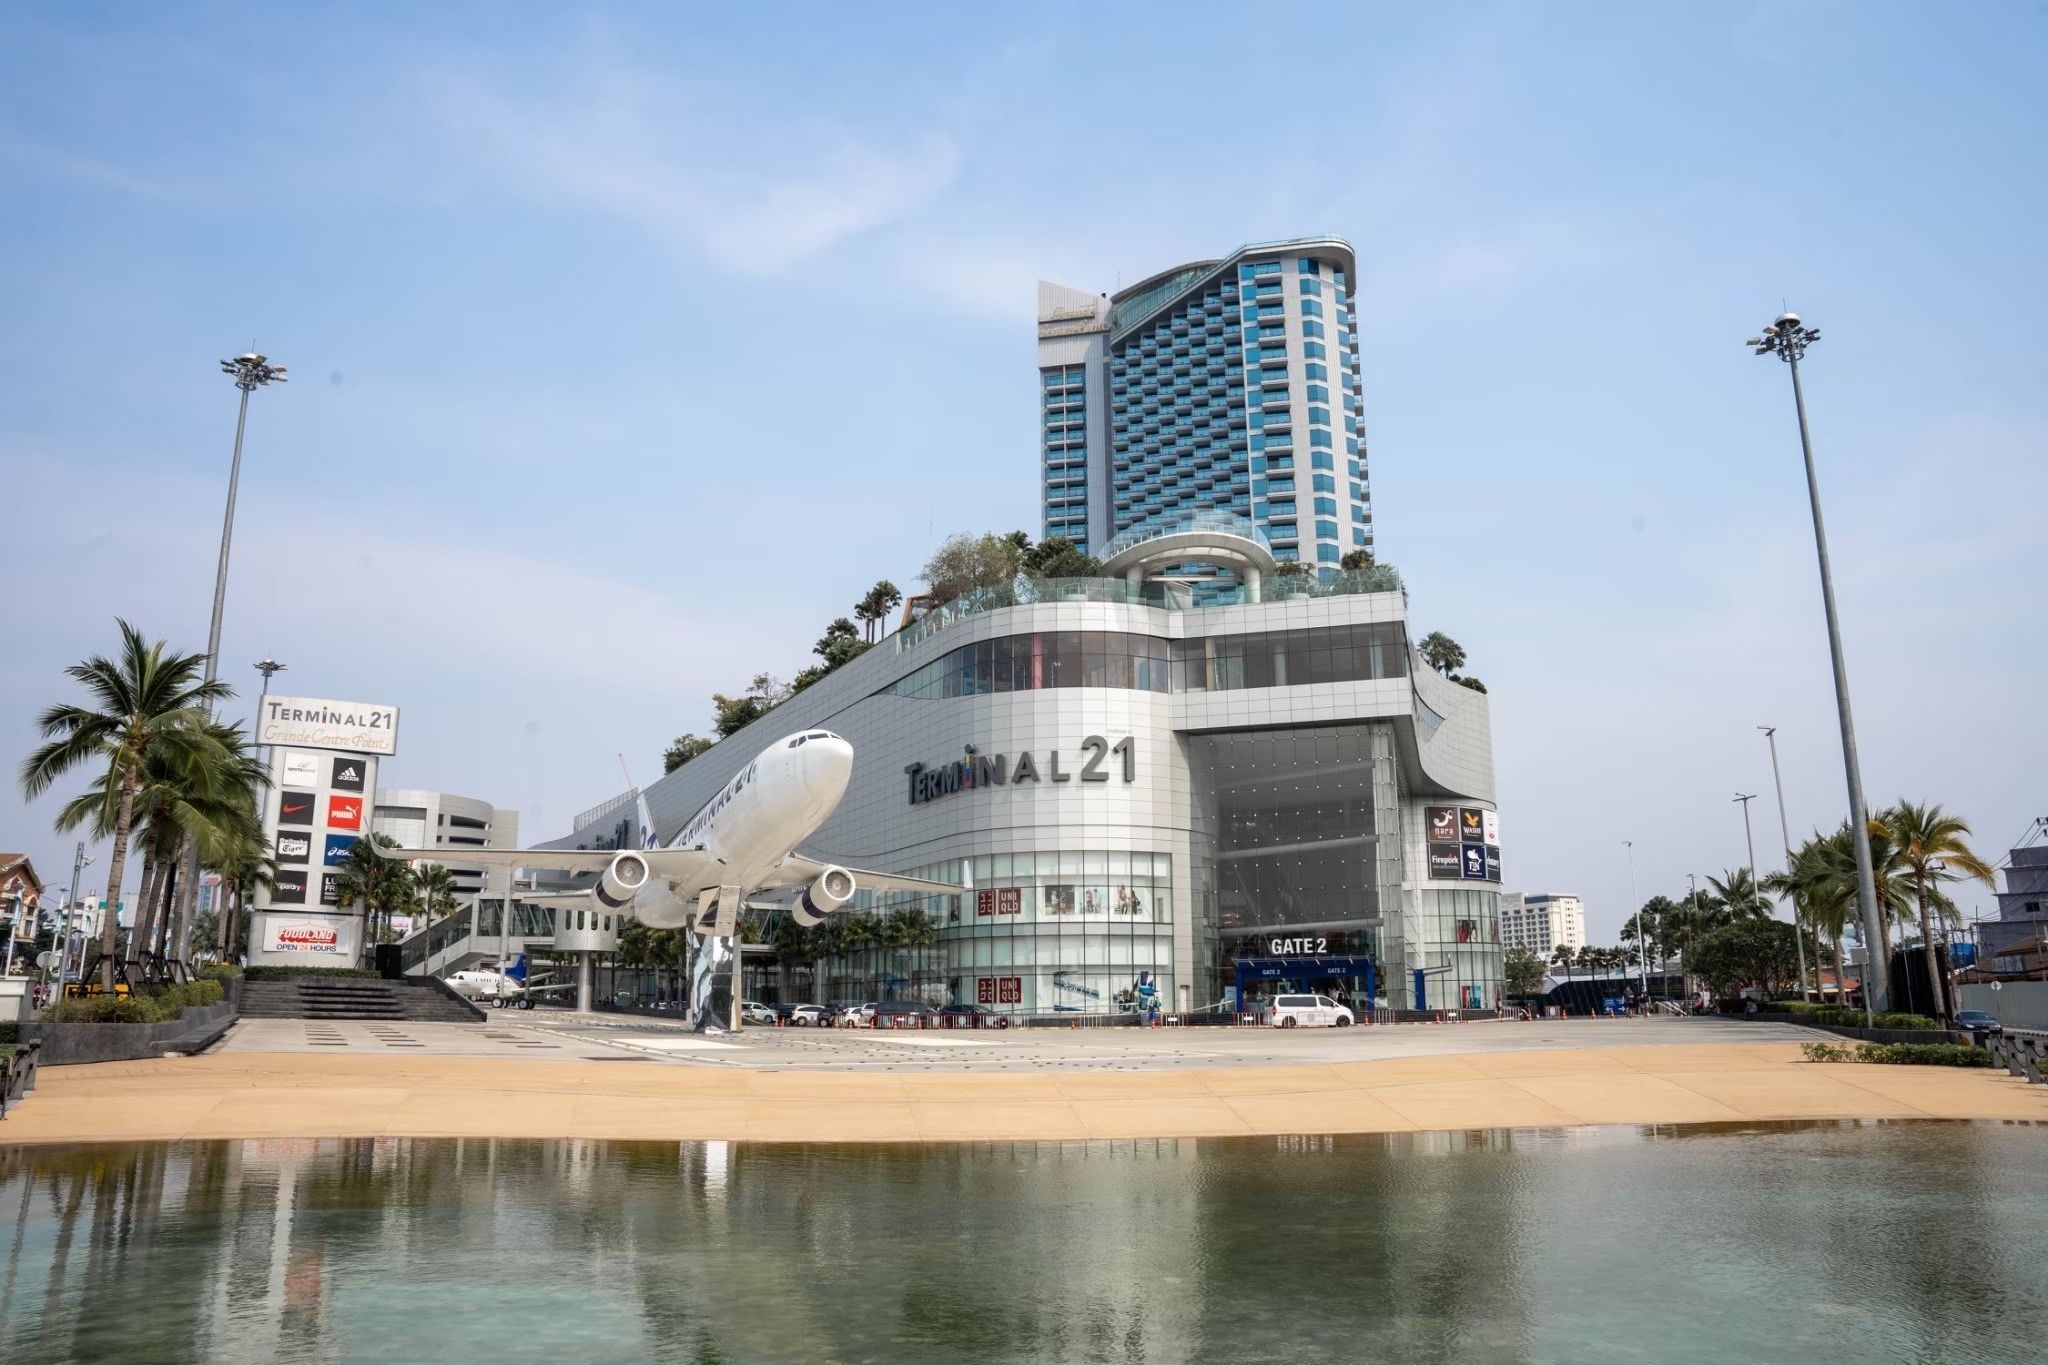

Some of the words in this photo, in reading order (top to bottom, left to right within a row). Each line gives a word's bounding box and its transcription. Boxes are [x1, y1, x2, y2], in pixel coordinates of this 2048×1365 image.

[264, 725, 310, 743] Grande
[311, 728, 352, 746] Centre
[352, 732, 389, 750] Point
[331, 810, 355, 819] PUMA
[279, 929, 334, 940] FOODLAND
[1271, 938, 1313, 955] GATE
[1316, 937, 1327, 953] 2
